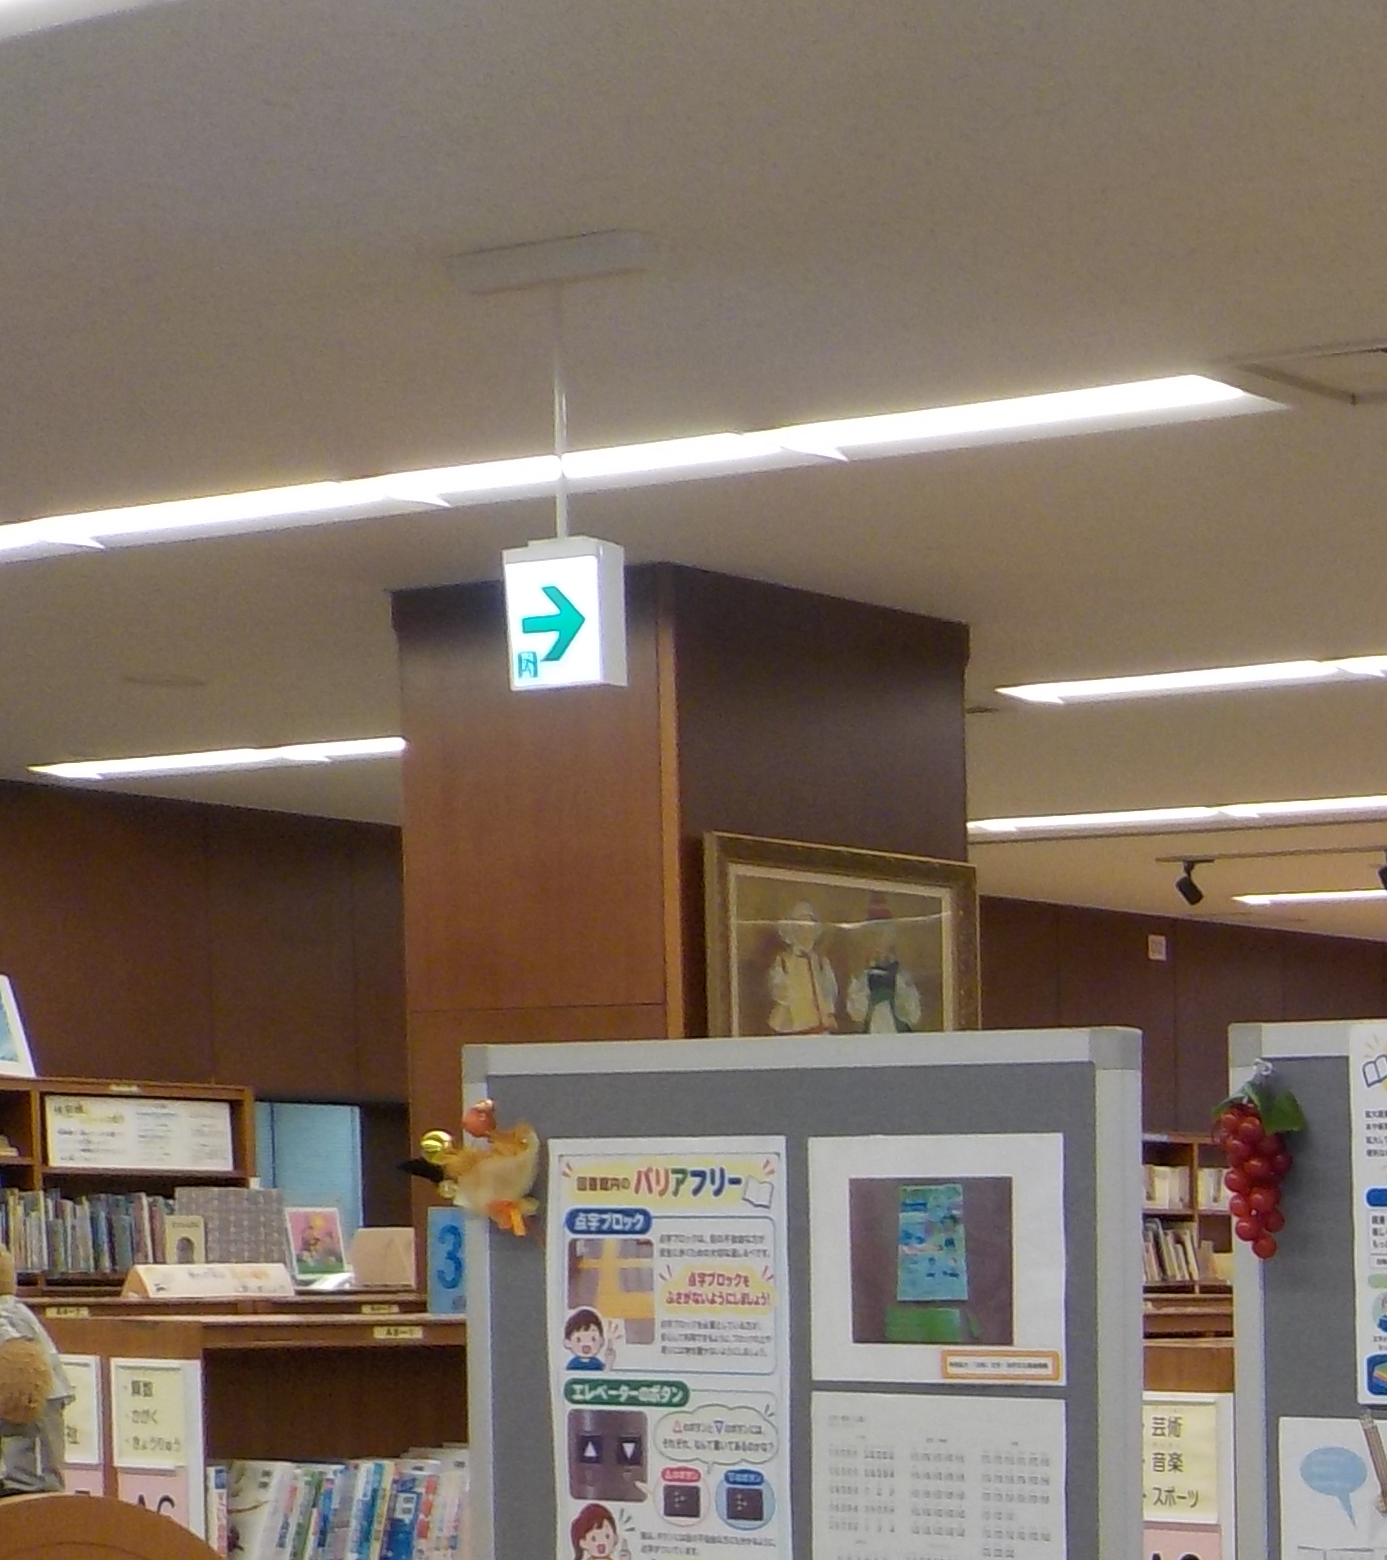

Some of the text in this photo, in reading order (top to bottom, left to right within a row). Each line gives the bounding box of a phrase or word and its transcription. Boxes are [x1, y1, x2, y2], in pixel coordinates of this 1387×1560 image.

[574, 1212, 645, 1231] 点字ブロック
[437, 1225, 463, 1290] 3
[687, 1271, 750, 1288] 点字ブロックを
[572, 1384, 684, 1402] エレベーターのボタン
[1151, 1415, 1184, 1439] 芸術
[1152, 1450, 1184, 1476] 音楽
[1152, 1485, 1200, 1510] スポーツ
